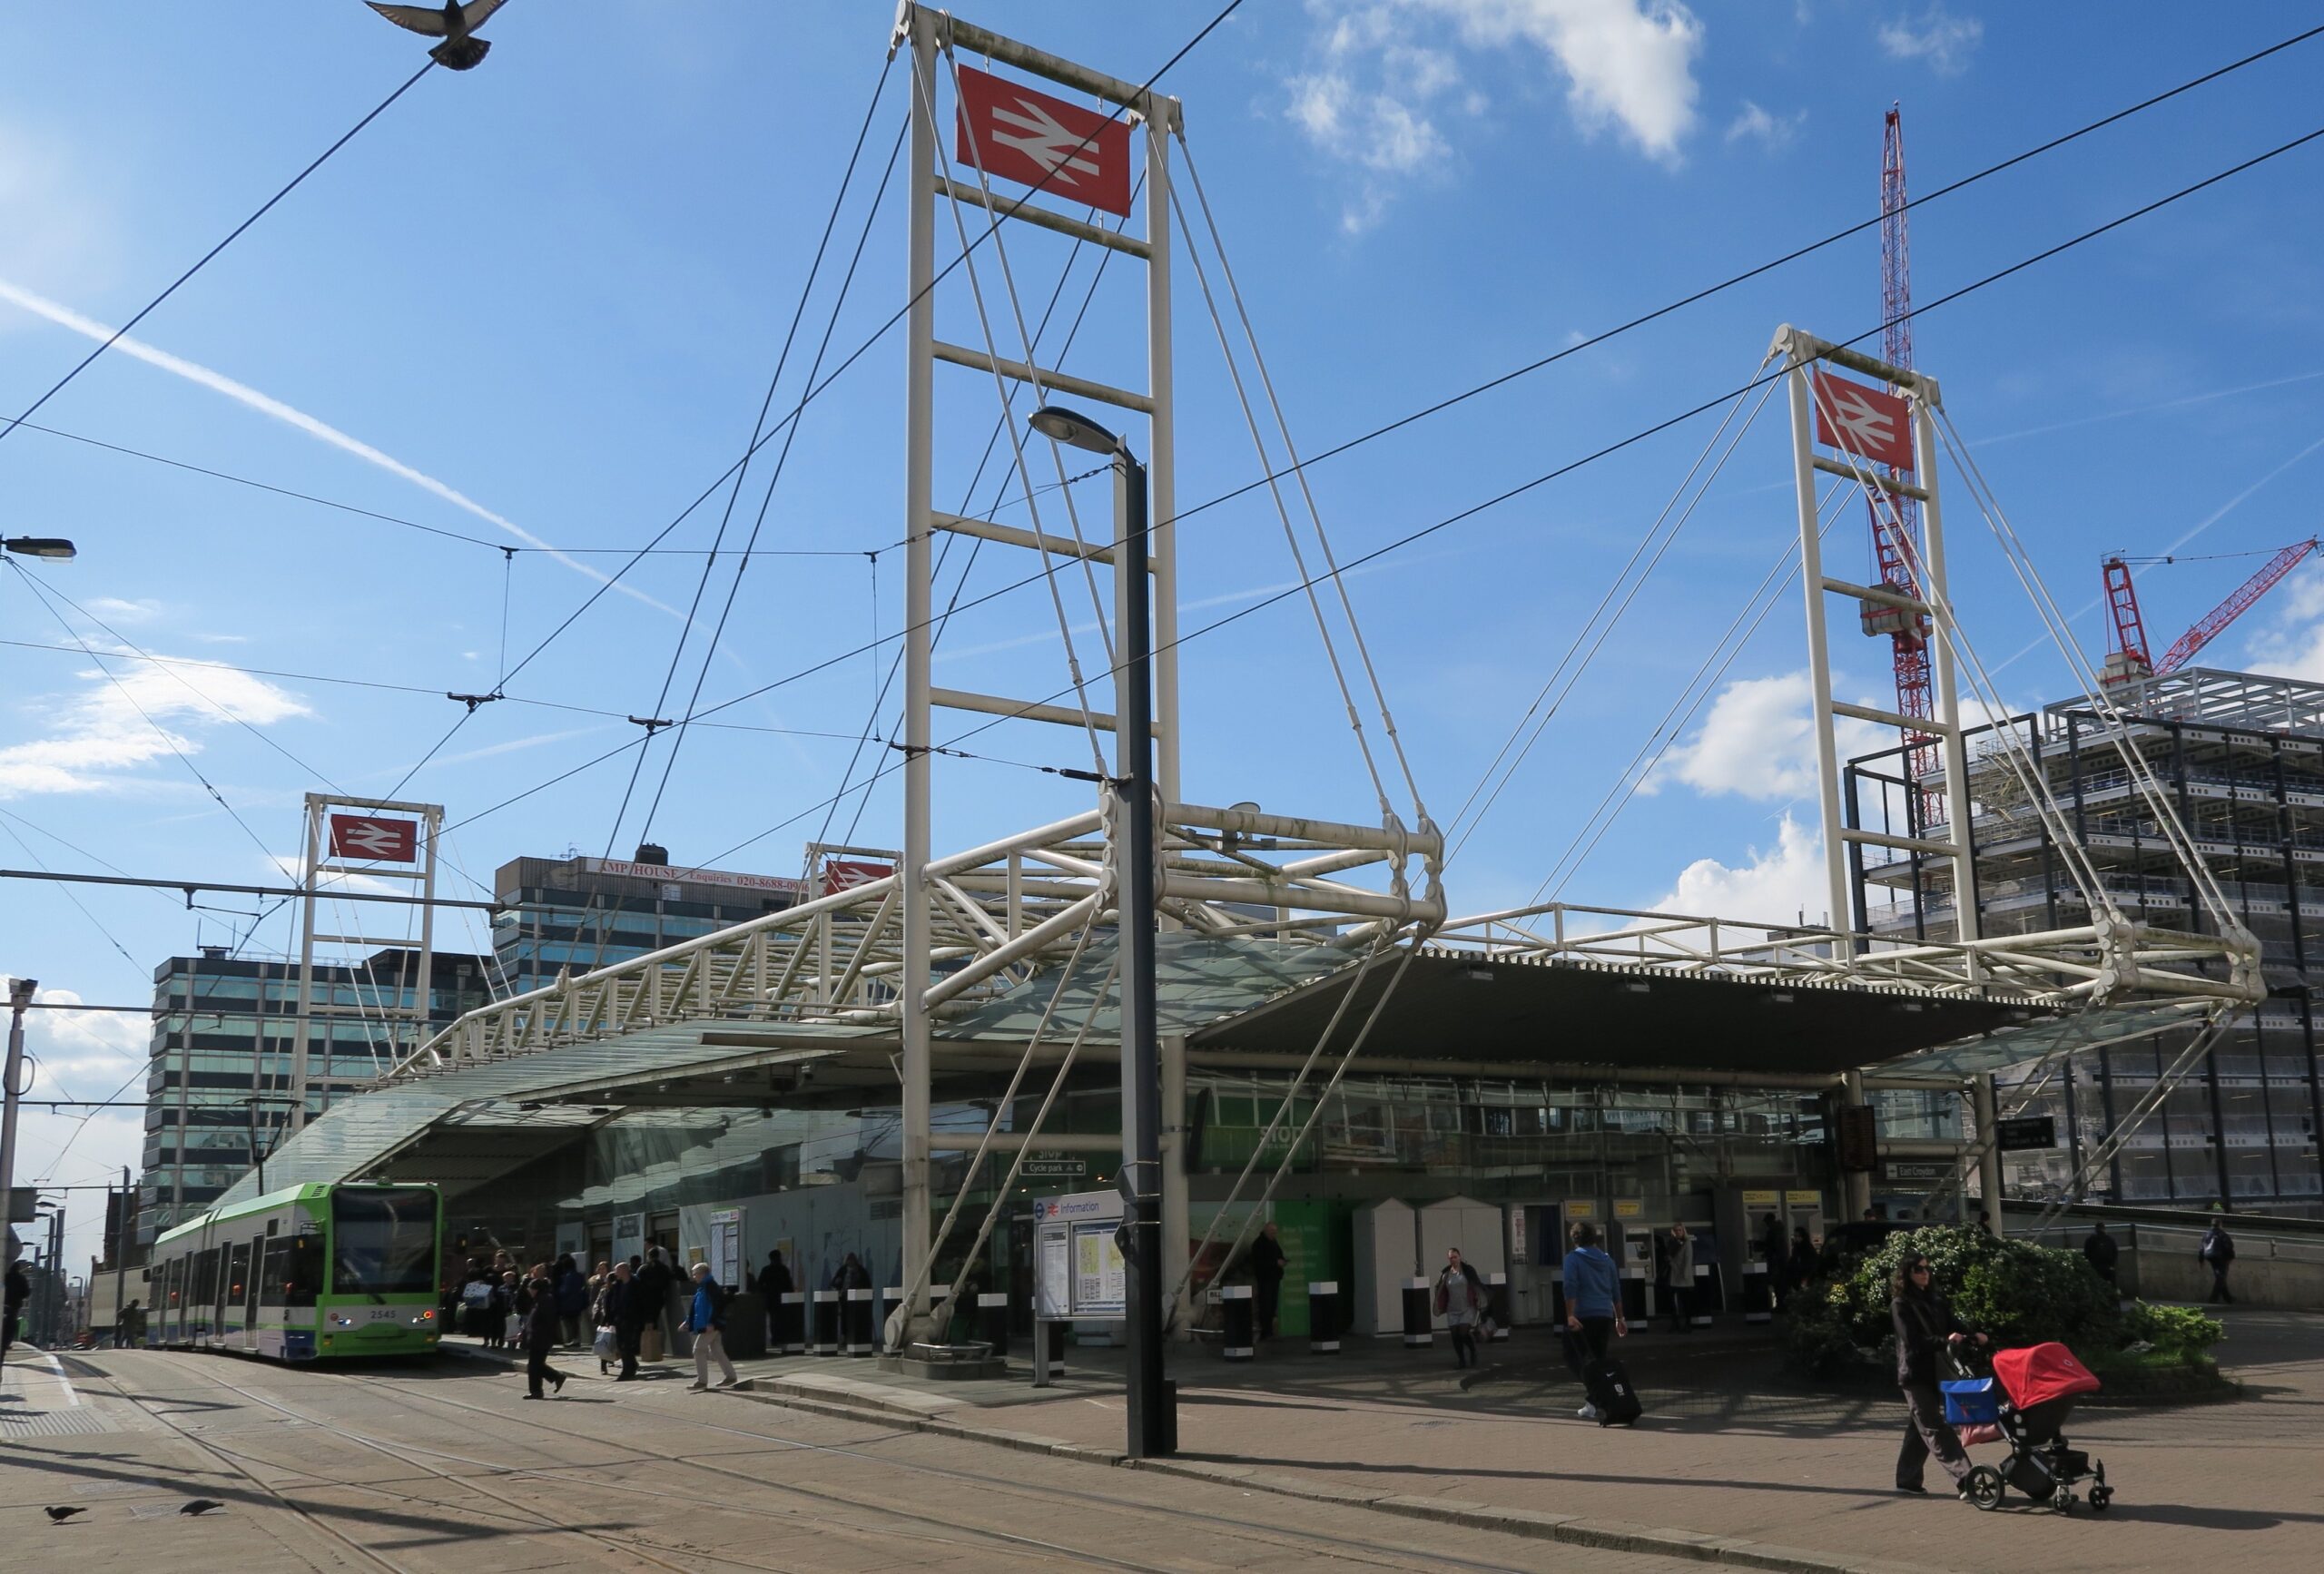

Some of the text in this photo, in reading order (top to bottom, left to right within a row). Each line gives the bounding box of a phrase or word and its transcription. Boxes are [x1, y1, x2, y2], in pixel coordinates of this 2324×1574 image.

[635, 863, 678, 878] HOUSE
[690, 871, 731, 882] Enquiries
[1029, 1163, 1063, 1174] Cycle park
[1899, 1166, 1936, 1177] East Croydon
[1060, 1202, 1099, 1215] Information
[370, 1310, 396, 1319] 2545
